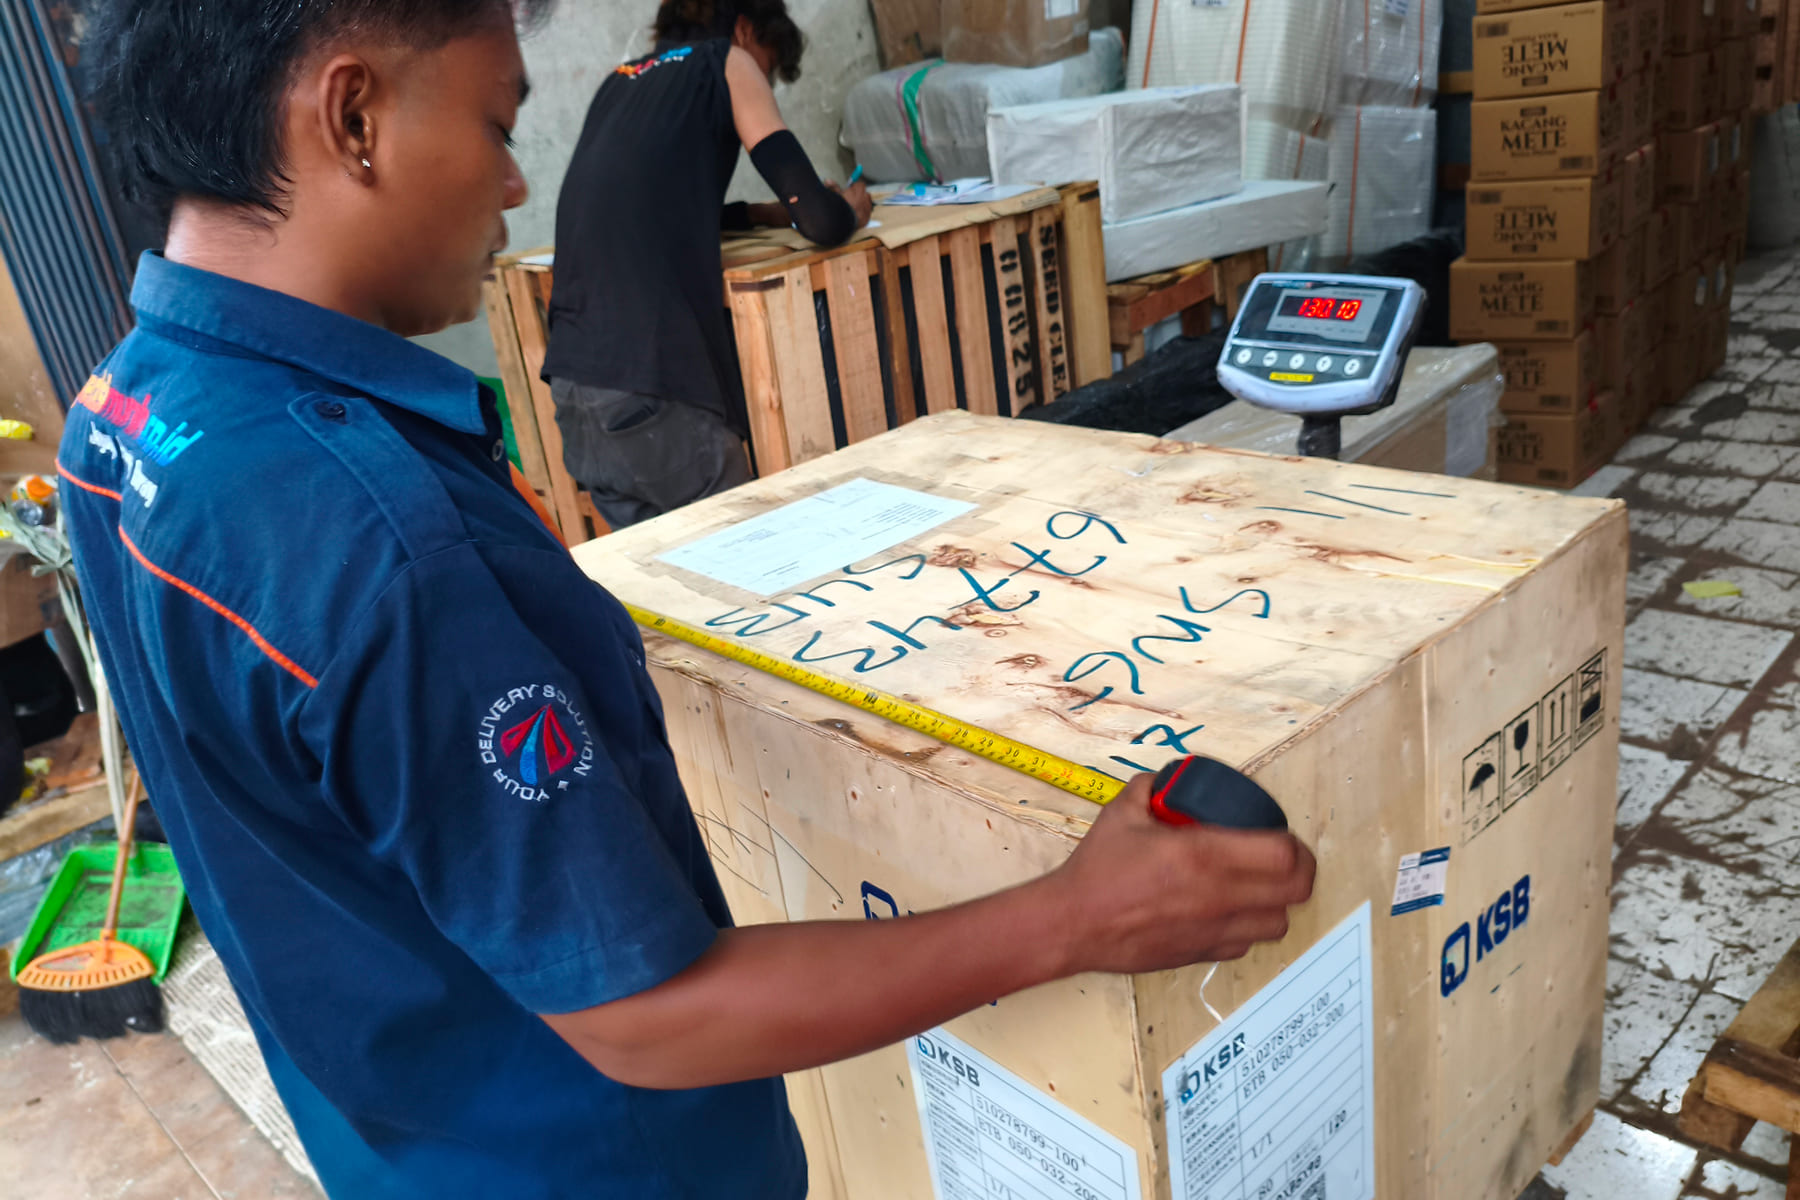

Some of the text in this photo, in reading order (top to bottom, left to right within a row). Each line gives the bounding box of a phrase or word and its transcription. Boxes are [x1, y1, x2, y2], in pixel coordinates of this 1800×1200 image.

[1502, 39, 1569, 63] METE
[1502, 59, 1569, 77] KACANG
[1500, 115, 1567, 132] KACANG
[1502, 129, 1567, 151] METE
[1494, 211, 1557, 231] METE
[1480, 294, 1544, 313] METE
[478, 684, 593, 802] YOUR DELIVERY SOLUTION
[980, 737, 994, 748] 29
[1005, 747, 1020, 758] 30
[1032, 757, 1046, 768] 31
[1060, 768, 1074, 779] 32
[1088, 779, 1104, 791] 33
[1476, 874, 1531, 963] KSB
[937, 1045, 980, 1087] KSB
[1203, 1031, 1245, 1082] KSB
[1242, 1003, 1345, 1099] ETB 050-032-200
[975, 1097, 1080, 1172] 510278799-100
[978, 1116, 1002, 1141] ETB
